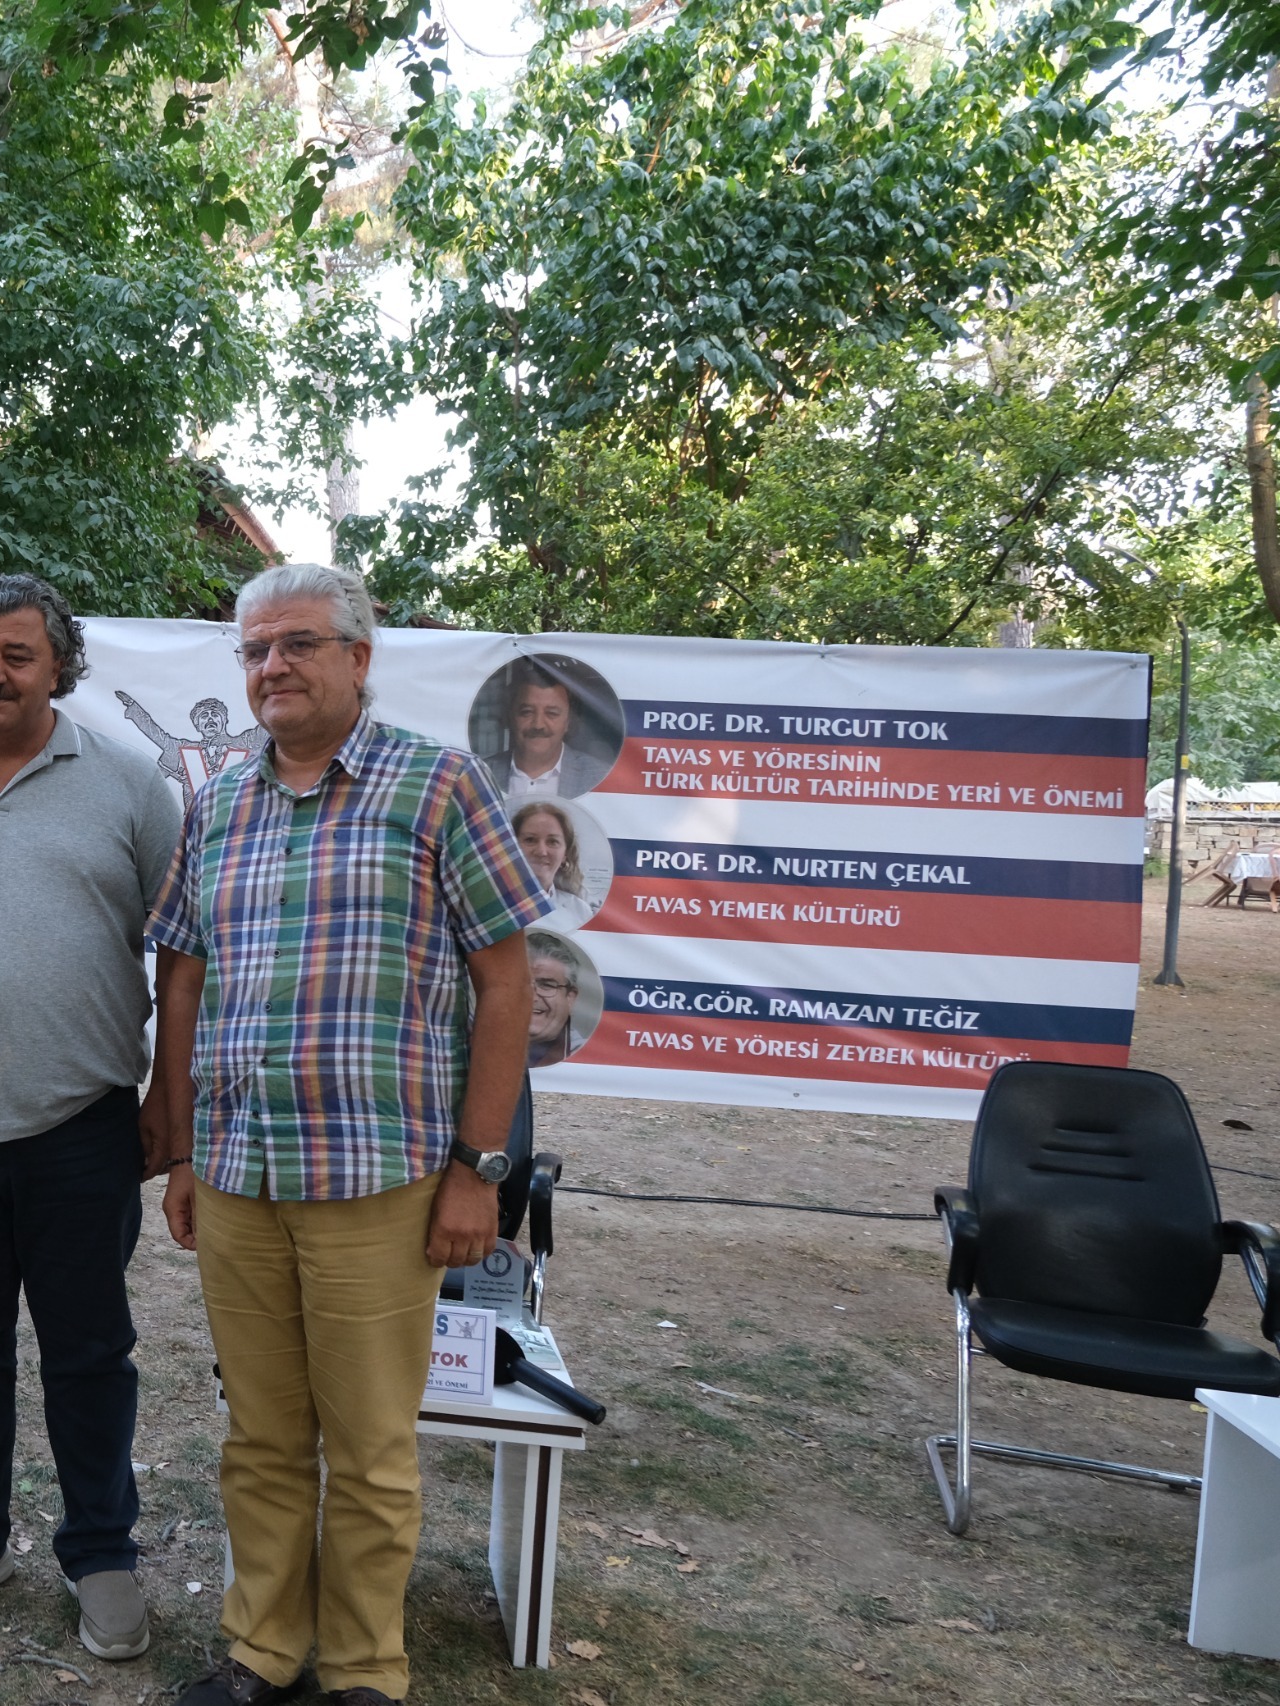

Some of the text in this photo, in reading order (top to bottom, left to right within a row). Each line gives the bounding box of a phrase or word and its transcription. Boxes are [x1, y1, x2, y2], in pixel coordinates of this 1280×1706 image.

[643, 711, 949, 741] PROF. DR. TURGUT TOK
[642, 746, 881, 773] TAVAS VE YÖRESİNİN
[641, 767, 1123, 809] TÜRK KÜLTÜR TARİHİNDE YERİ VE ÖNEMİ
[635, 849, 971, 888] PROF. DR. NURTEN ÇEKAL
[632, 895, 901, 927] TAVAS YEMEK KÜLTÜRÜ
[628, 985, 980, 1030] ÖĞR.GÖR. RAMAZAN TEĞİZ
[625, 1030, 1031, 1070] TAVAS VE YÖRESİ ZEYBEK KÜLTÜ
[431, 1351, 468, 1368] TOK
[445, 1380, 468, 1389] ÖNEMİ
